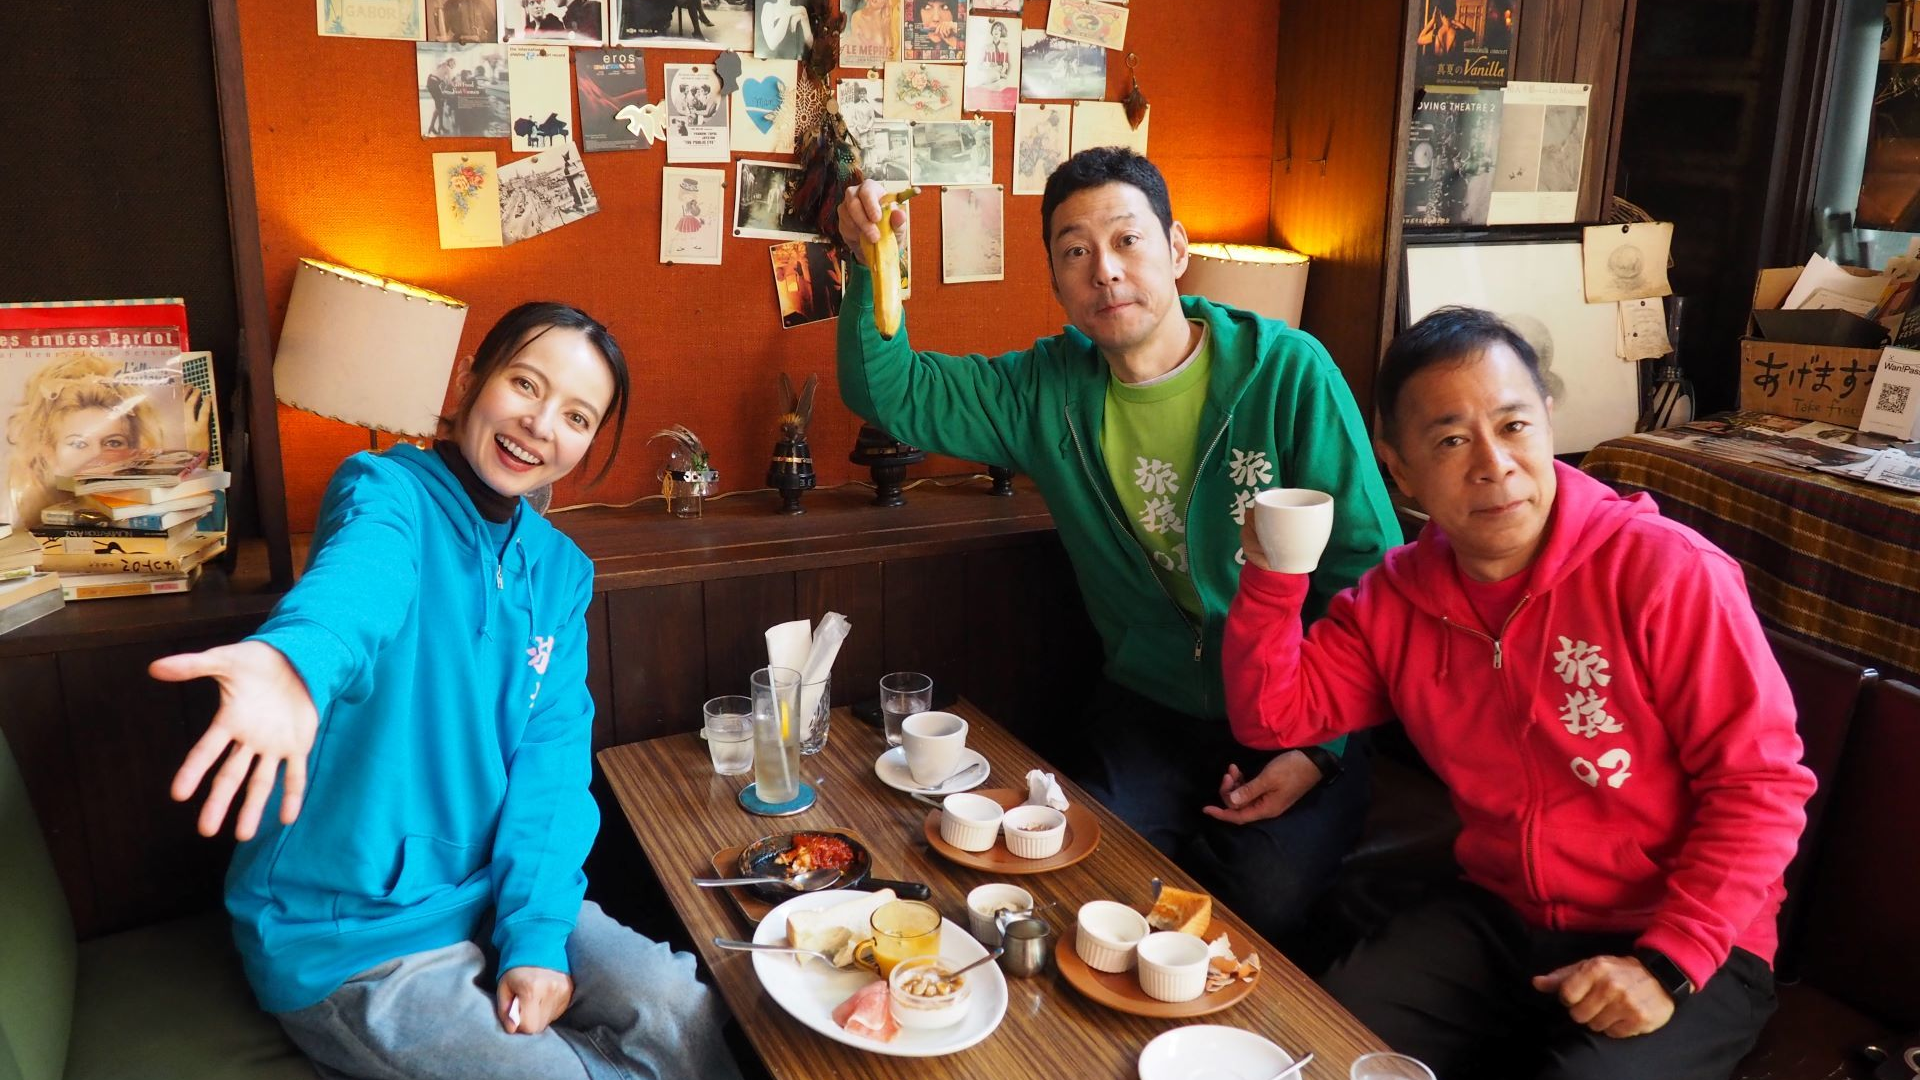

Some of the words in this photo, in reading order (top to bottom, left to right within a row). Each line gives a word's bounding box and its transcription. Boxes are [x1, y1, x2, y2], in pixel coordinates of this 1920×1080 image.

[346, 5, 397, 19] GABOR
[603, 54, 635, 64] eros
[1463, 55, 1505, 77] Vanilla
[1449, 102, 1489, 112] THEATRE
[1490, 103, 1496, 112] 2
[31, 332, 100, 346] années
[109, 331, 173, 345] Bardot
[1884, 361, 1920, 376] Wan!Pas
